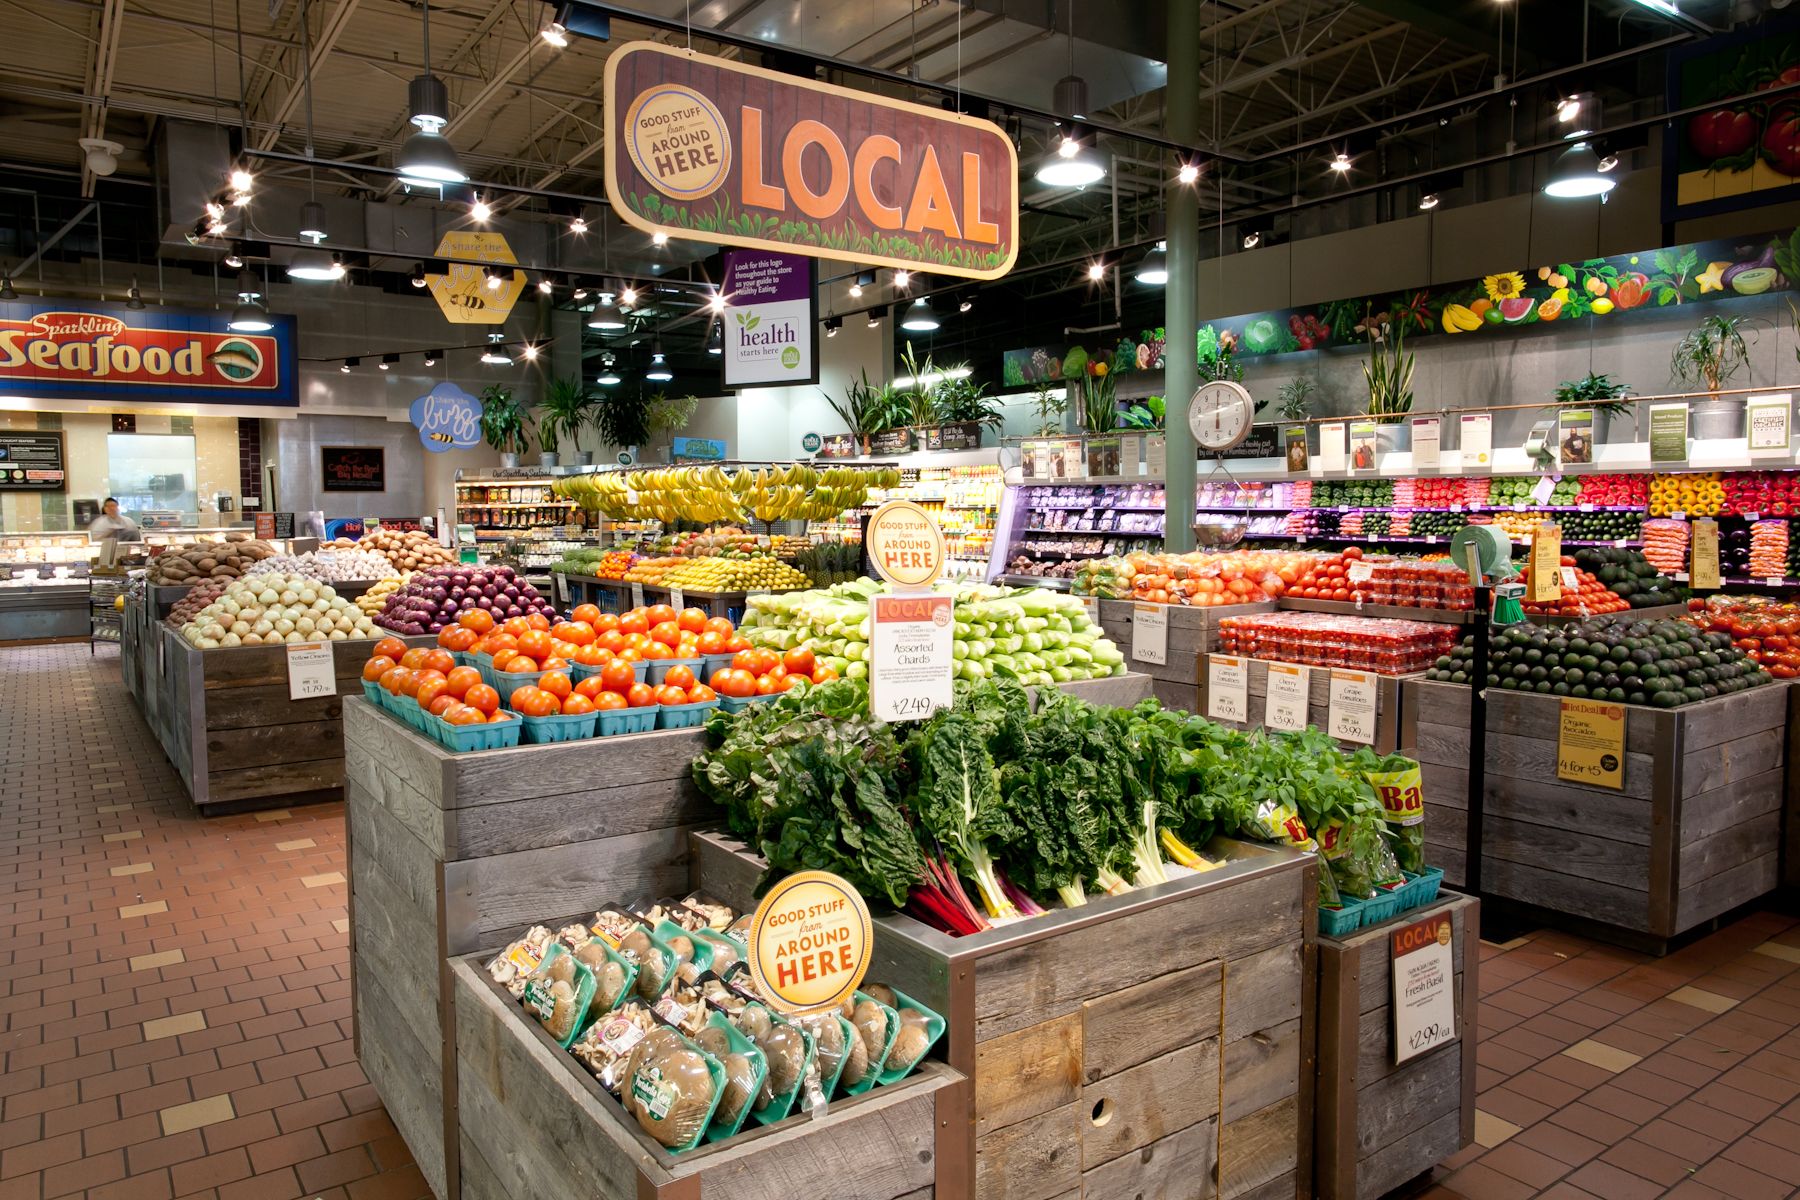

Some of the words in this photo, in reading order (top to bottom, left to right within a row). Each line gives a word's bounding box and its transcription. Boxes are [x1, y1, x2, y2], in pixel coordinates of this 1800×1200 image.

[640, 114, 670, 128] GOOD
[671, 106, 700, 122] STUFF
[666, 124, 686, 138] from
[652, 130, 710, 154] AROUND
[654, 144, 718, 178] HERE
[741, 104, 999, 244] LOCAL
[452, 242, 480, 252] share
[484, 243, 502, 252] the
[749, 261, 758, 269] for
[770, 260, 783, 268] logo
[735, 270, 766, 282] throughout
[778, 266, 792, 274] store
[742, 280, 756, 288] your
[756, 278, 772, 286] guide
[758, 286, 778, 294] Eating.
[26, 314, 125, 340] Sparkling
[740, 322, 796, 346] health
[0, 330, 204, 377] Seafood
[740, 349, 760, 357] starts
[762, 346, 779, 355] here
[345, 522, 361, 532] Hot
[880, 522, 904, 530] GOOD
[905, 522, 928, 530] STUFF
[884, 540, 931, 550] AROUND
[885, 552, 933, 568] HERE
[878, 600, 933, 619] LOCAL
[894, 642, 934, 654] Assorted
[898, 654, 930, 664] Chards
[1278, 678, 1296, 687] Cherry
[1344, 687, 1362, 696] Grape
[1340, 694, 1367, 704] Tomatoes
[1568, 704, 1580, 712] Hot
[1581, 704, 1599, 714] Deal
[1564, 719, 1590, 728] Organic
[1563, 726, 1596, 736] Avocados
[1560, 760, 1567, 770] 4
[1570, 760, 1586, 773] for
[1379, 786, 1422, 811] Ba
[768, 909, 806, 928] GOOD
[809, 899, 845, 918] STUFF
[798, 920, 823, 937] from
[776, 926, 850, 960] AROUND
[1396, 922, 1438, 952] LOCAL
[777, 944, 854, 988] HERE
[1406, 981, 1426, 998] Fresh
[1426, 972, 1444, 990] Basil
